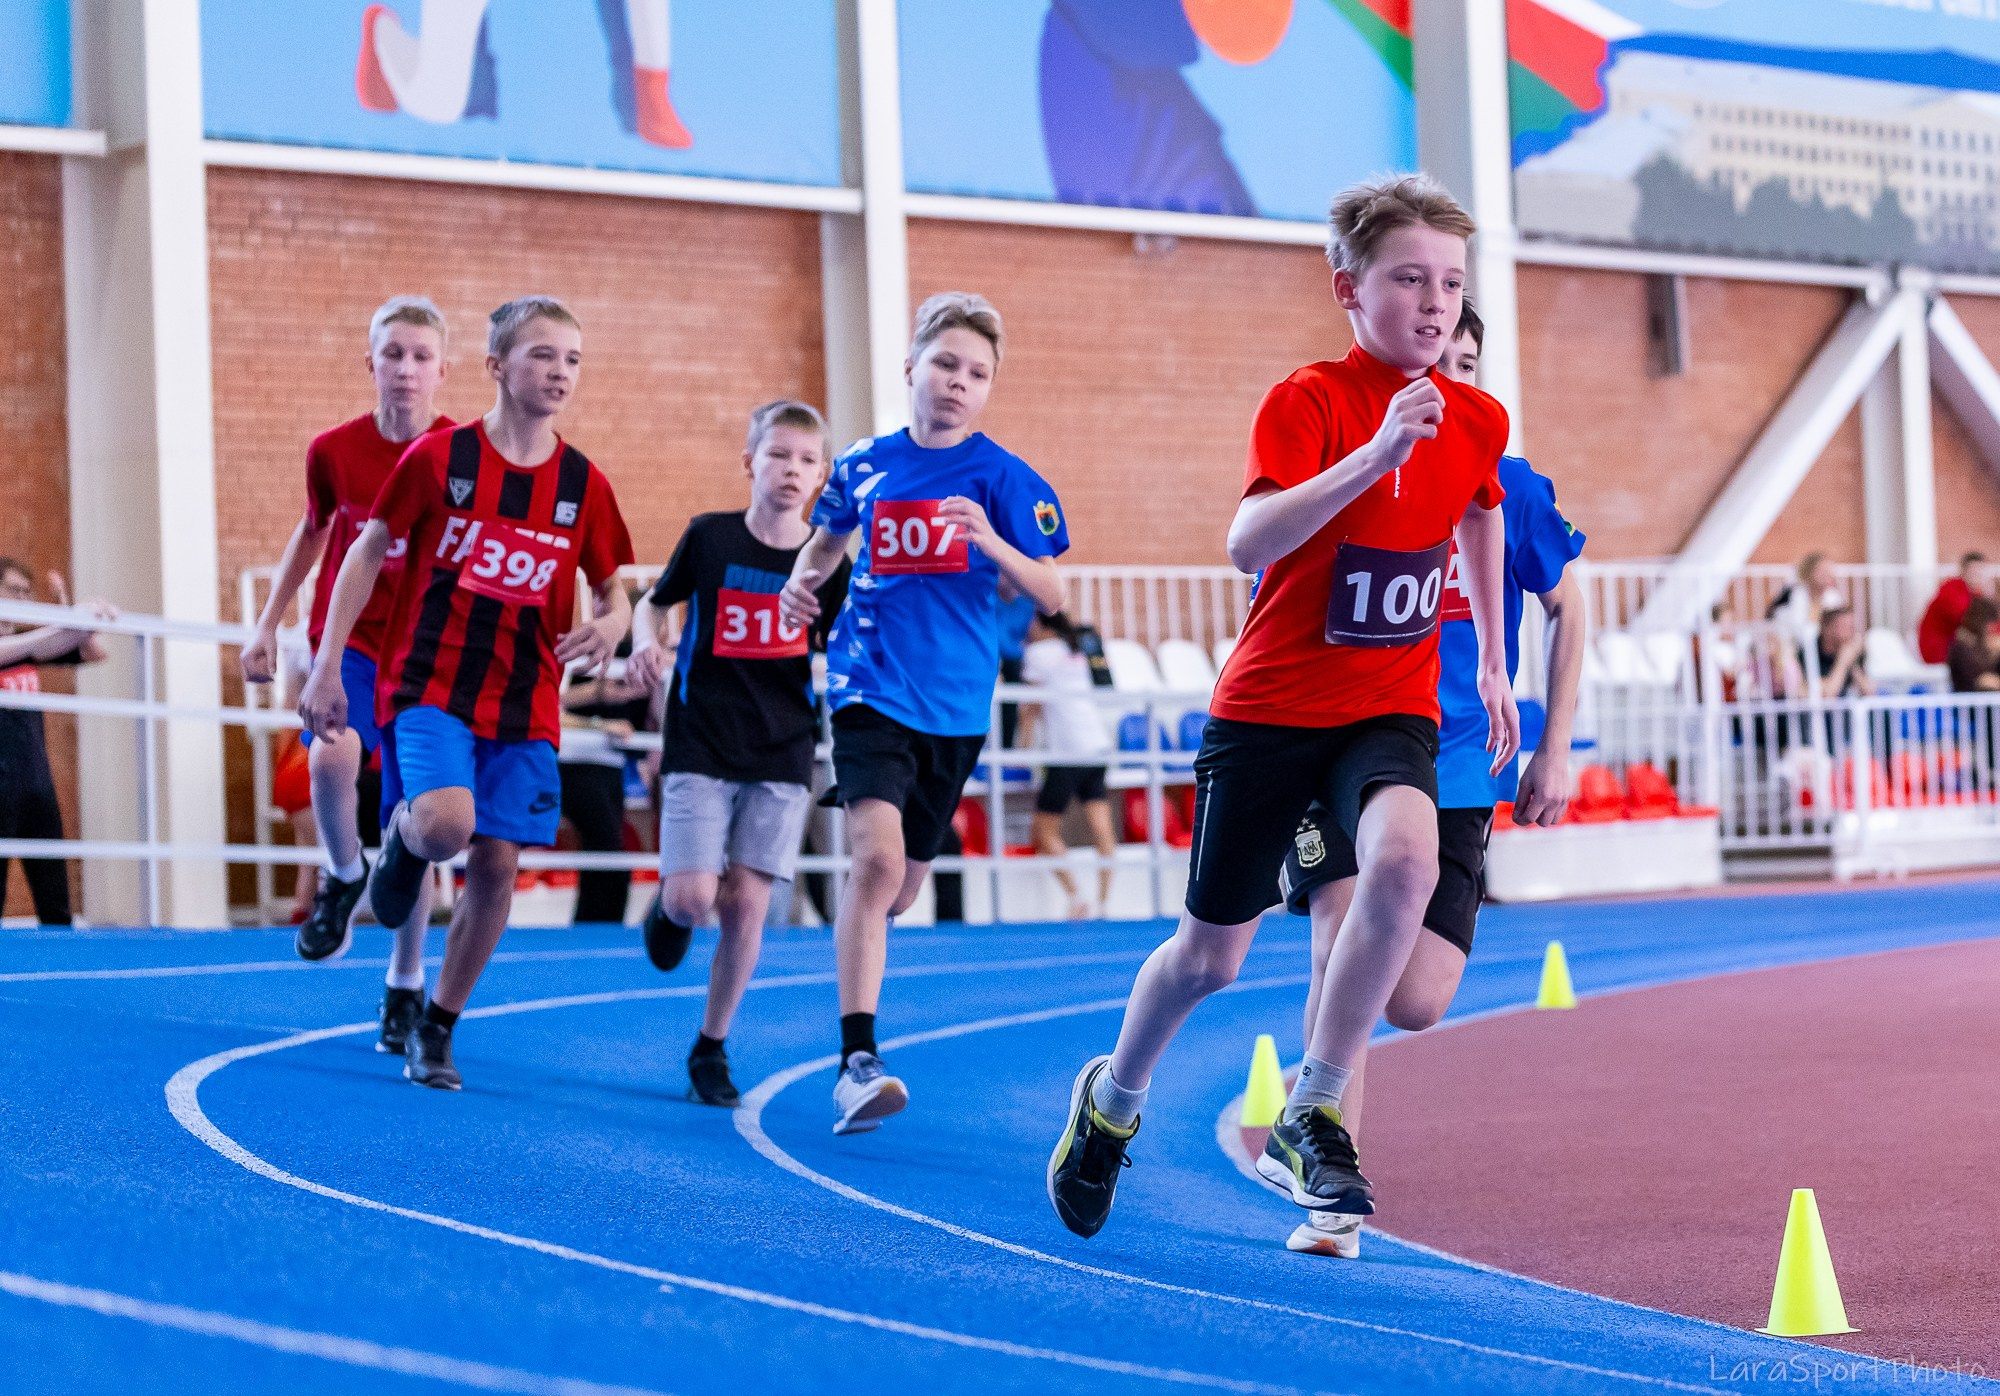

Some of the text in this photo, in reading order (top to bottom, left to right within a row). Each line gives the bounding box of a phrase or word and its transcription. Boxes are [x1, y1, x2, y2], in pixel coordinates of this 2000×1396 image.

[877, 516, 959, 558] 307
[471, 538, 558, 592] 398
[1346, 567, 1442, 625] 100
